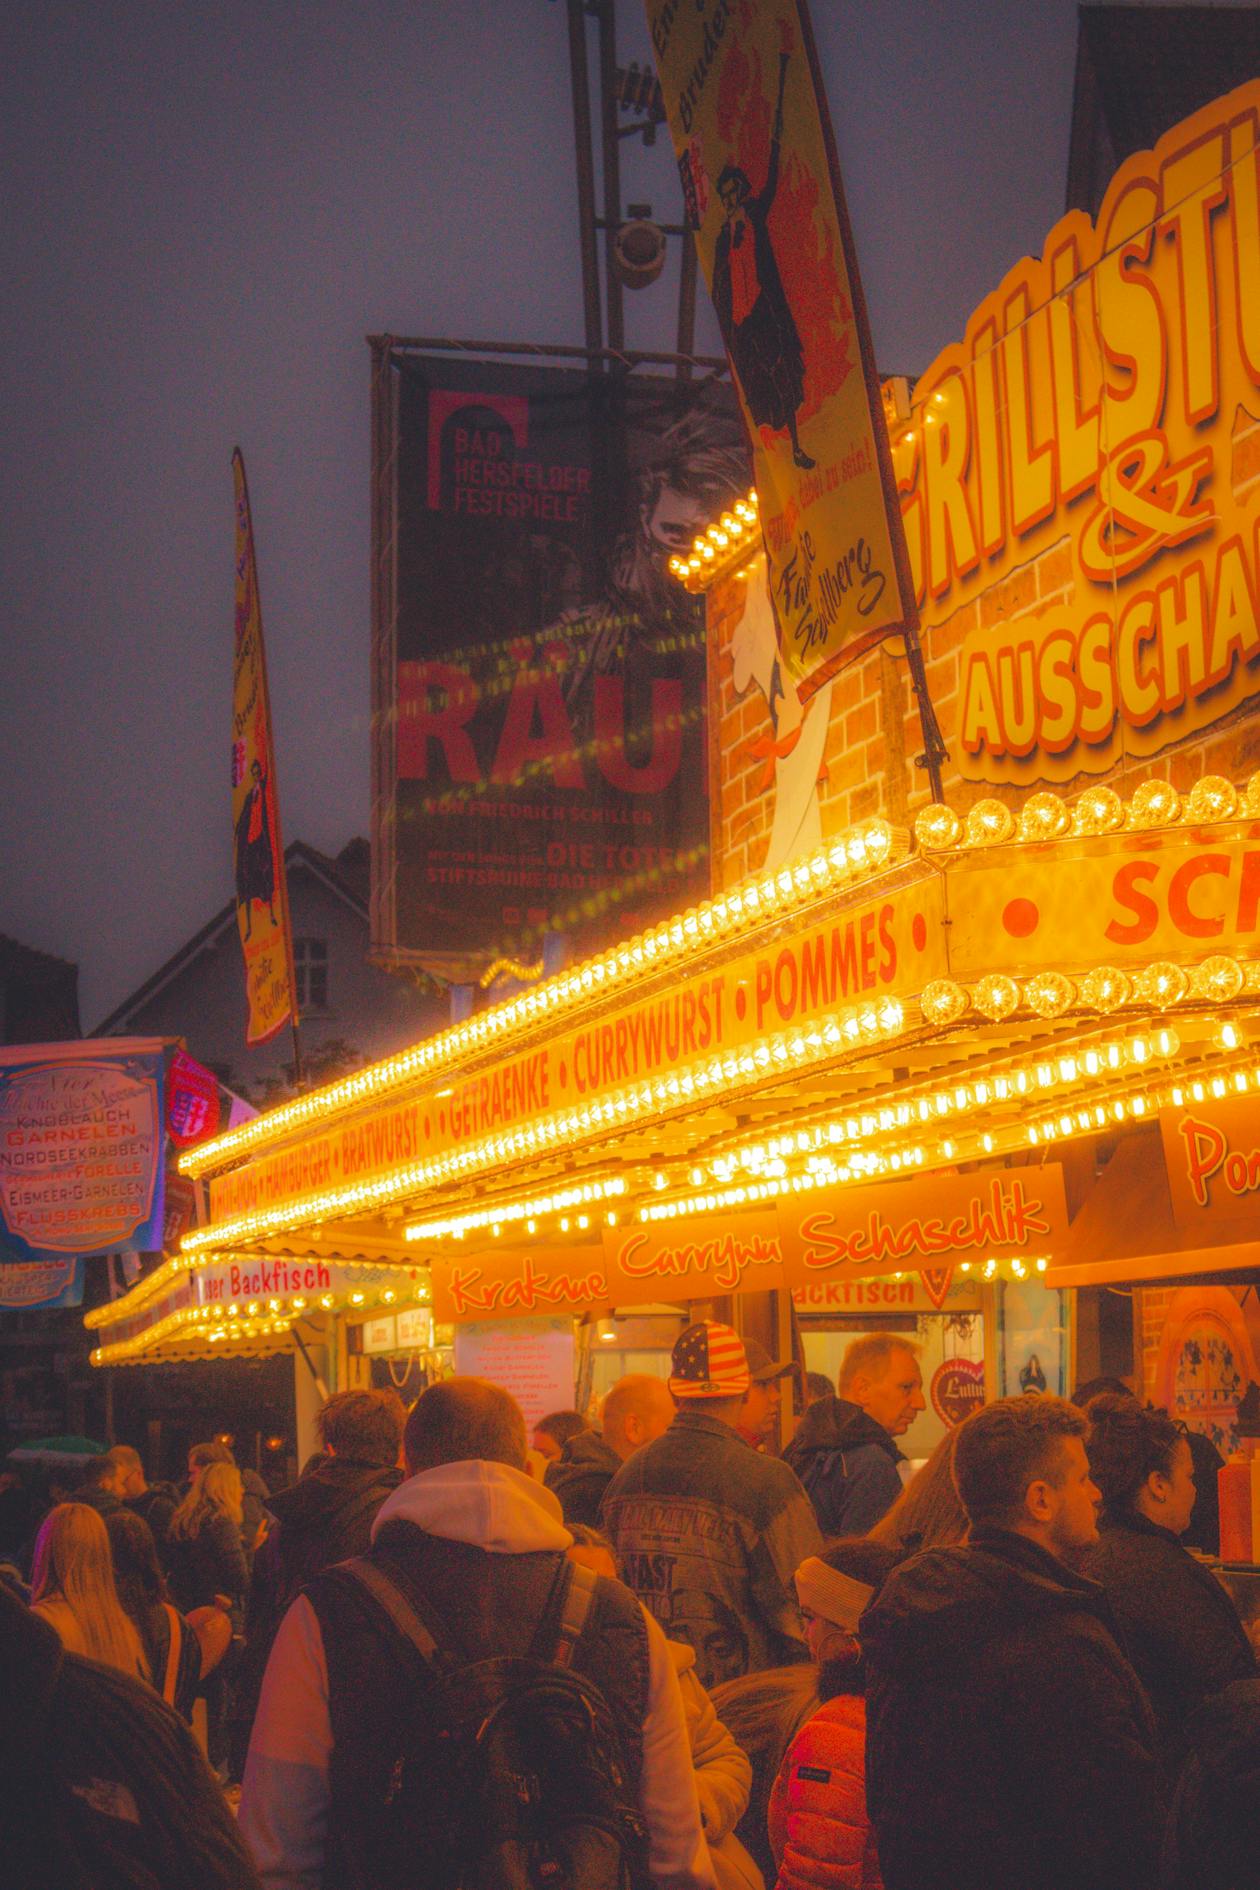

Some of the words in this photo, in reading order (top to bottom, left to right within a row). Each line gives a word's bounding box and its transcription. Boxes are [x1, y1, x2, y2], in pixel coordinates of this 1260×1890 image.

[455, 427, 501, 456] BAD
[455, 487, 577, 522] FESTSPIELE
[1078, 429, 1216, 582] &
[961, 515, 1260, 757] AUSSCHA
[397, 637, 708, 794] RÄU
[468, 800, 565, 821] FRIEDRICH
[570, 806, 653, 825] SCHILLER
[546, 842, 594, 868] DIE
[426, 867, 543, 888] STIFTSRUINE
[342, 1106, 418, 1176] BRATWURST
[449, 1050, 550, 1140] GETRAENKE
[573, 983, 725, 1088] CURRYWURST
[756, 903, 898, 1030] POMMES
[16, 1109, 130, 1129] KNOBLAUCH
[6, 1124, 137, 1148] GARNELEN
[0, 1143, 150, 1167] NORDSEEKRABBEN
[75, 1162, 142, 1179] FORELLE
[9, 1182, 144, 1207] EISMEER-GARNELEN
[16, 1203, 140, 1226] FLUSSKREBS
[800, 1179, 1050, 1269] Schaschlik
[230, 1260, 331, 1296] Backfisch
